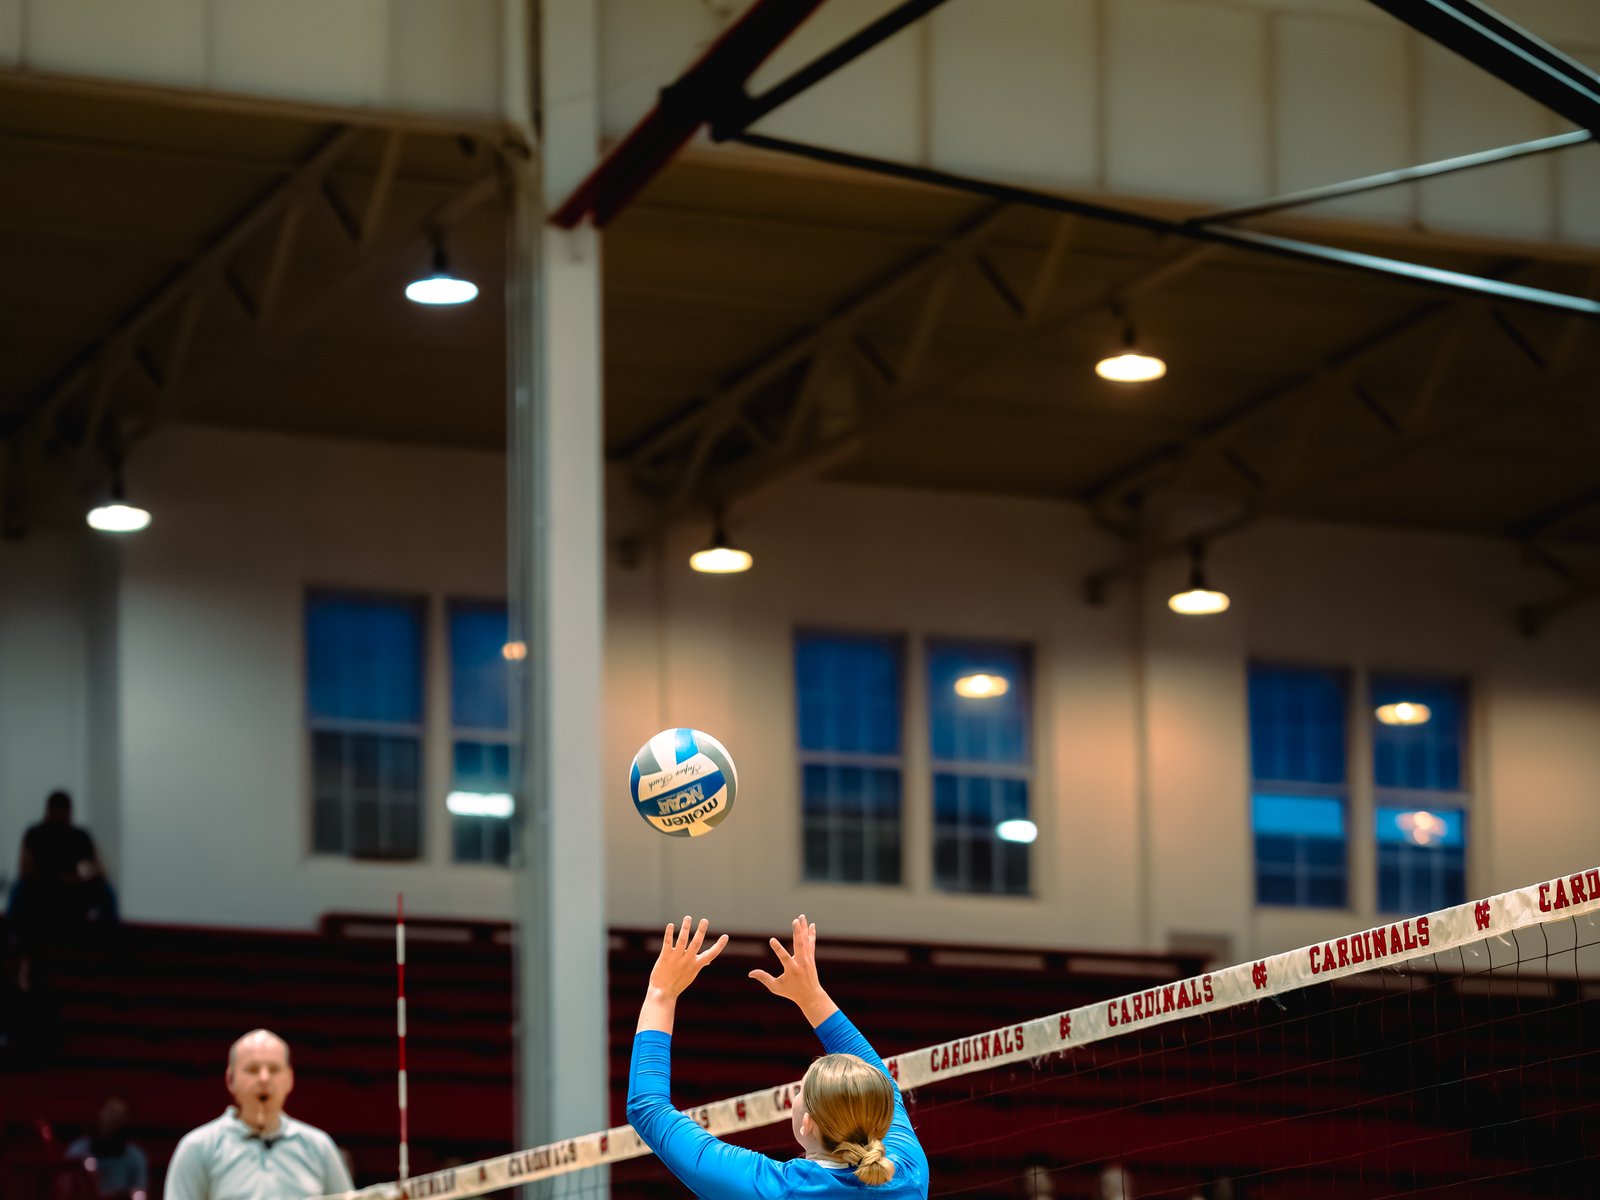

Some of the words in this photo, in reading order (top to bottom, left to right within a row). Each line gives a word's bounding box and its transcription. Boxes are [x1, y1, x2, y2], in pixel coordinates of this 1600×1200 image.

[656, 783, 705, 816] NCAA
[661, 798, 719, 827] molten
[930, 1026, 1025, 1073] CARDINALS
[1107, 975, 1215, 1027] CARDINALS
[1309, 916, 1431, 975] CARDINALS
[1538, 868, 1600, 914] CARD
